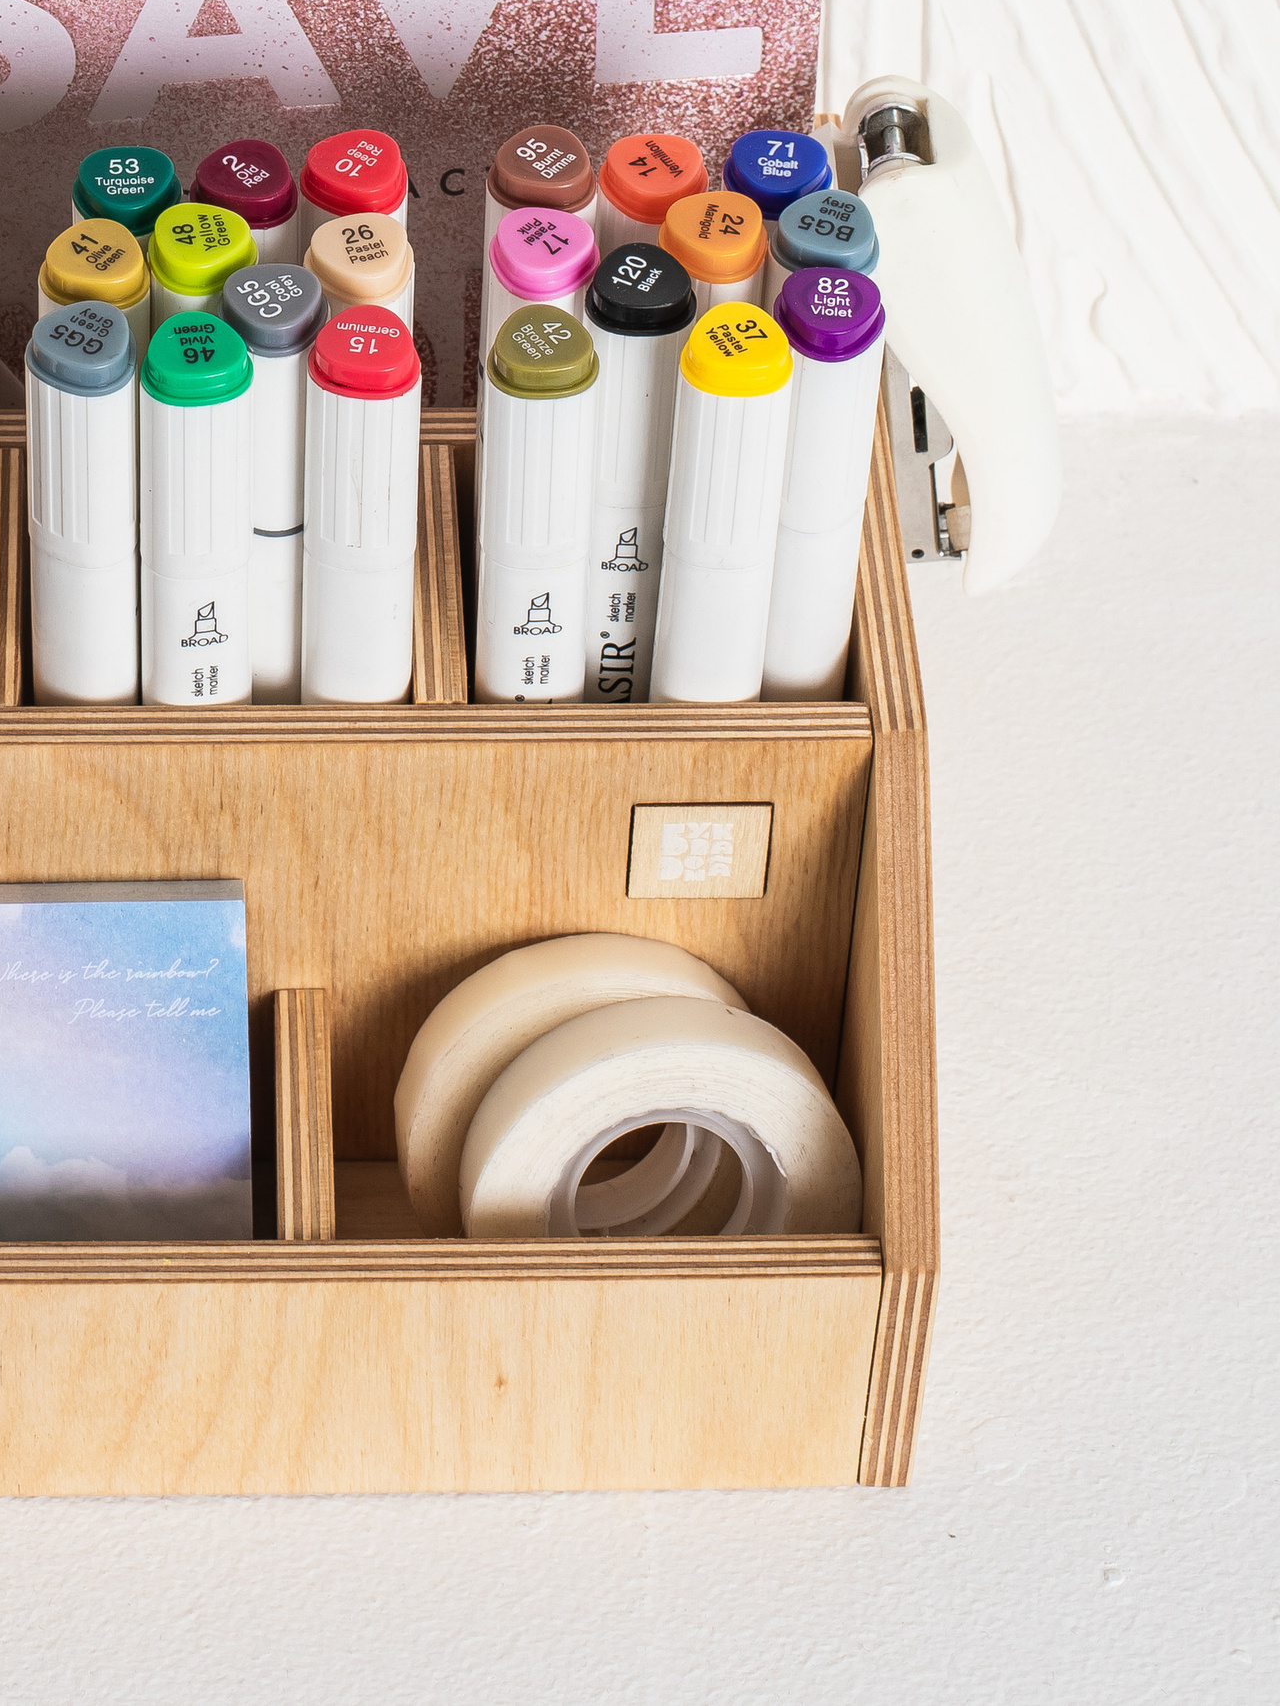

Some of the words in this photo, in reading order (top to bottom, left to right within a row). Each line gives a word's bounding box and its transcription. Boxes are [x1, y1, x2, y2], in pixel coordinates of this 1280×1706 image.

[346, 147, 378, 167] Deep
[357, 140, 384, 157] Red
[516, 137, 548, 162] 95
[645, 140, 684, 178] Vermilion
[767, 140, 795, 158] 71
[108, 158, 140, 175] 53
[221, 154, 246, 174] 2
[334, 157, 363, 178] 10
[532, 148, 564, 172] Burnt
[628, 156, 658, 177] 14
[757, 157, 799, 170] Cobalt
[95, 176, 155, 187] Turquoise
[236, 164, 259, 181] Old
[242, 169, 270, 189] Red
[762, 166, 792, 178] Blue
[106, 185, 145, 195] Green
[819, 206, 851, 222] Blue
[821, 196, 856, 214] Grey
[212, 213, 231, 247] Green
[517, 217, 543, 235] Pink
[698, 203, 720, 240] Marigold
[719, 212, 745, 237] 24
[797, 214, 856, 243] BG5
[71, 233, 99, 255] 41
[172, 223, 197, 246] 48
[197, 214, 218, 252] Yellow
[341, 224, 375, 245] 26
[523, 221, 557, 246] Pastel
[85, 244, 112, 264] Olive
[345, 240, 385, 256] Pastel
[542, 233, 570, 256] 17
[95, 248, 126, 271] Green
[348, 248, 389, 264] Peach
[611, 254, 647, 287] 120
[637, 268, 663, 293] Black
[264, 279, 291, 302] Cool
[277, 274, 303, 297] Grey
[817, 277, 850, 295] 82
[235, 280, 283, 319] CG5
[814, 294, 851, 308] Light
[79, 307, 114, 329] Grey
[810, 305, 853, 318] Violet
[70, 315, 110, 338] Green
[173, 323, 216, 335] Green
[336, 321, 401, 338] Geranium
[542, 322, 572, 345] 42
[735, 319, 768, 340] 37
[49, 324, 104, 355] GG5
[179, 335, 214, 347] Vivid
[349, 336, 379, 355] 15
[511, 331, 542, 361] Green
[520, 323, 555, 357] Bronze
[705, 327, 735, 358] Yellow
[717, 324, 748, 354] Pastel
[182, 346, 216, 364] 46
[601, 561, 649, 573] BROAD
[607, 592, 621, 623] sketch
[623, 591, 636, 623] marker
[181, 634, 229, 647] BROAD
[513, 624, 562, 636] BROAD
[207, 665, 219, 696] marker
[521, 656, 535, 686] sketch
[538, 654, 551, 685] marker
[191, 667, 204, 697] sketch
[58, 968, 77, 984] is
[81, 959, 122, 981] the
[67, 997, 142, 1025] Please
[145, 997, 187, 1019] tell
[189, 1007, 221, 1018] me
